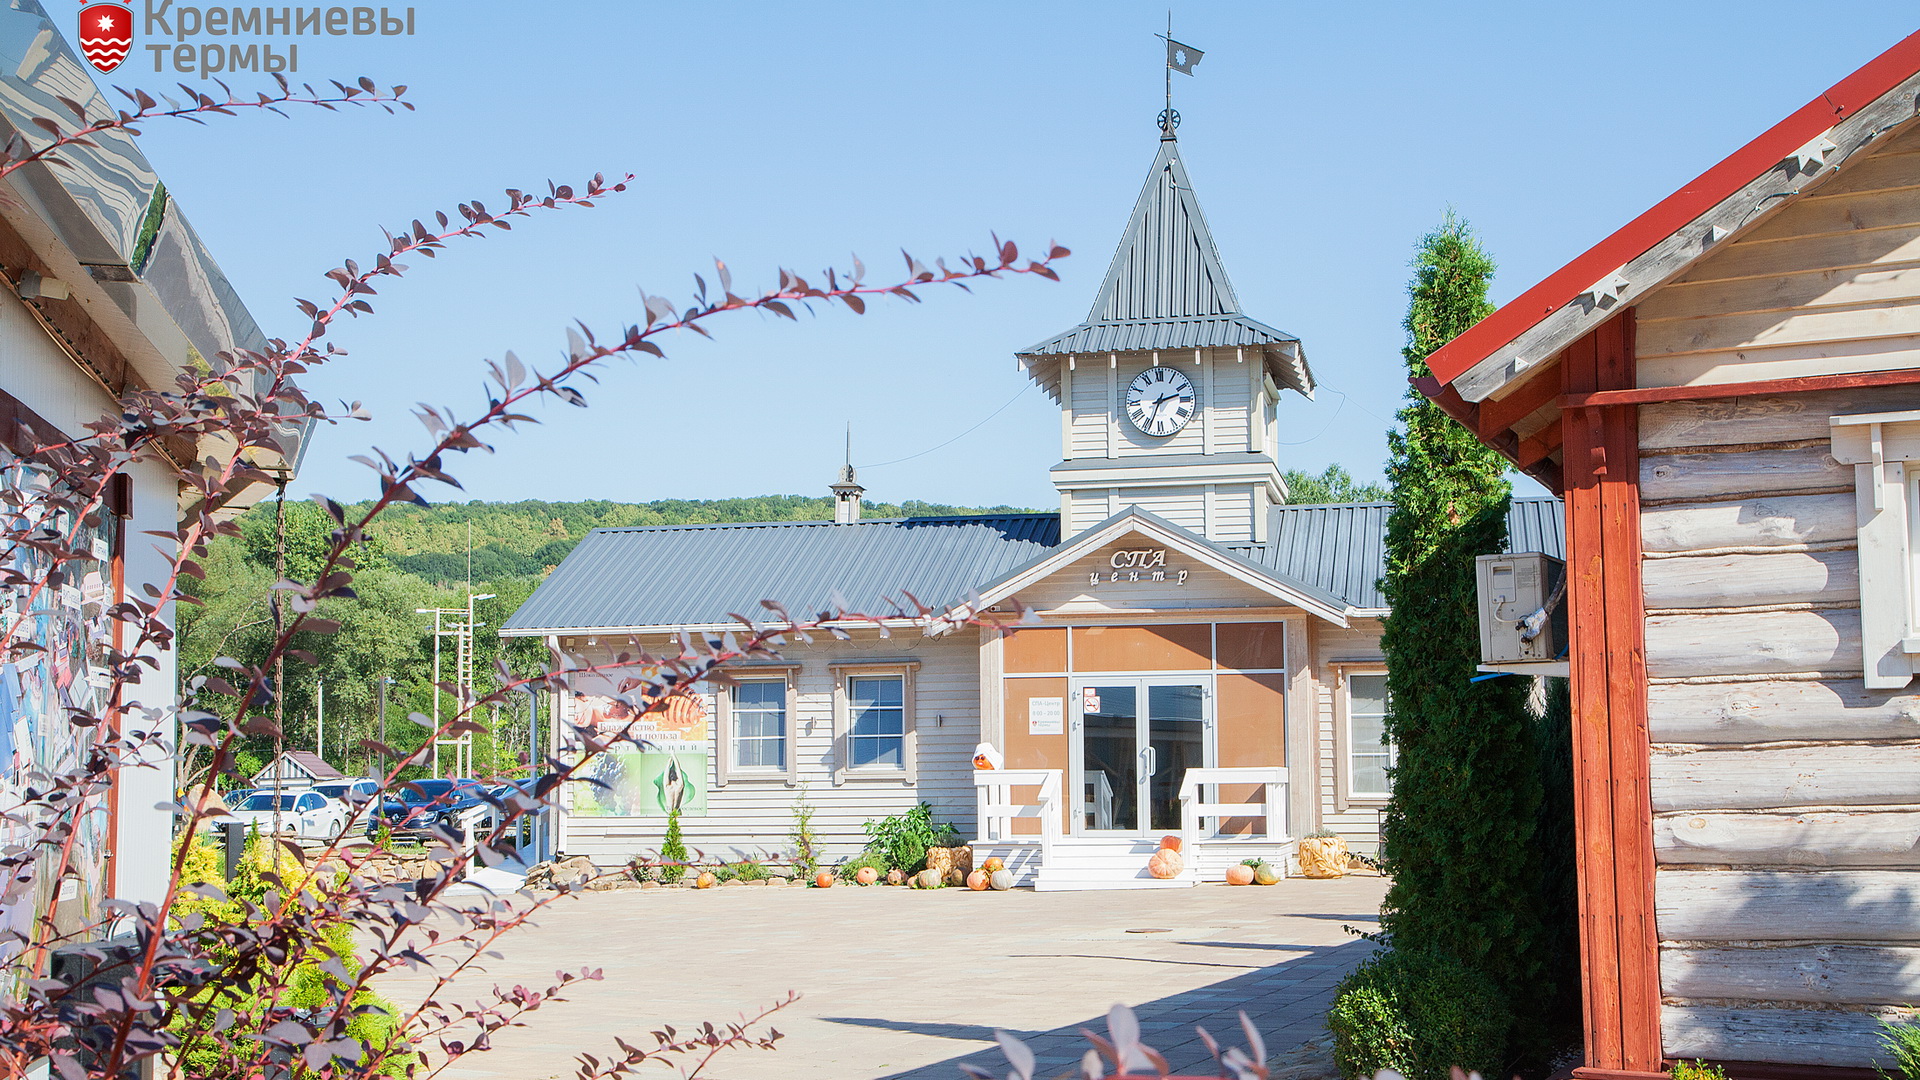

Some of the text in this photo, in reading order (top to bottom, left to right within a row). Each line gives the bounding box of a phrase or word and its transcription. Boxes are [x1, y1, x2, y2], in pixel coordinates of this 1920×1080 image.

[1110, 549, 1167, 569] СПА
[1089, 569, 1188, 586] центр
[600, 723, 655, 731] Блажство
